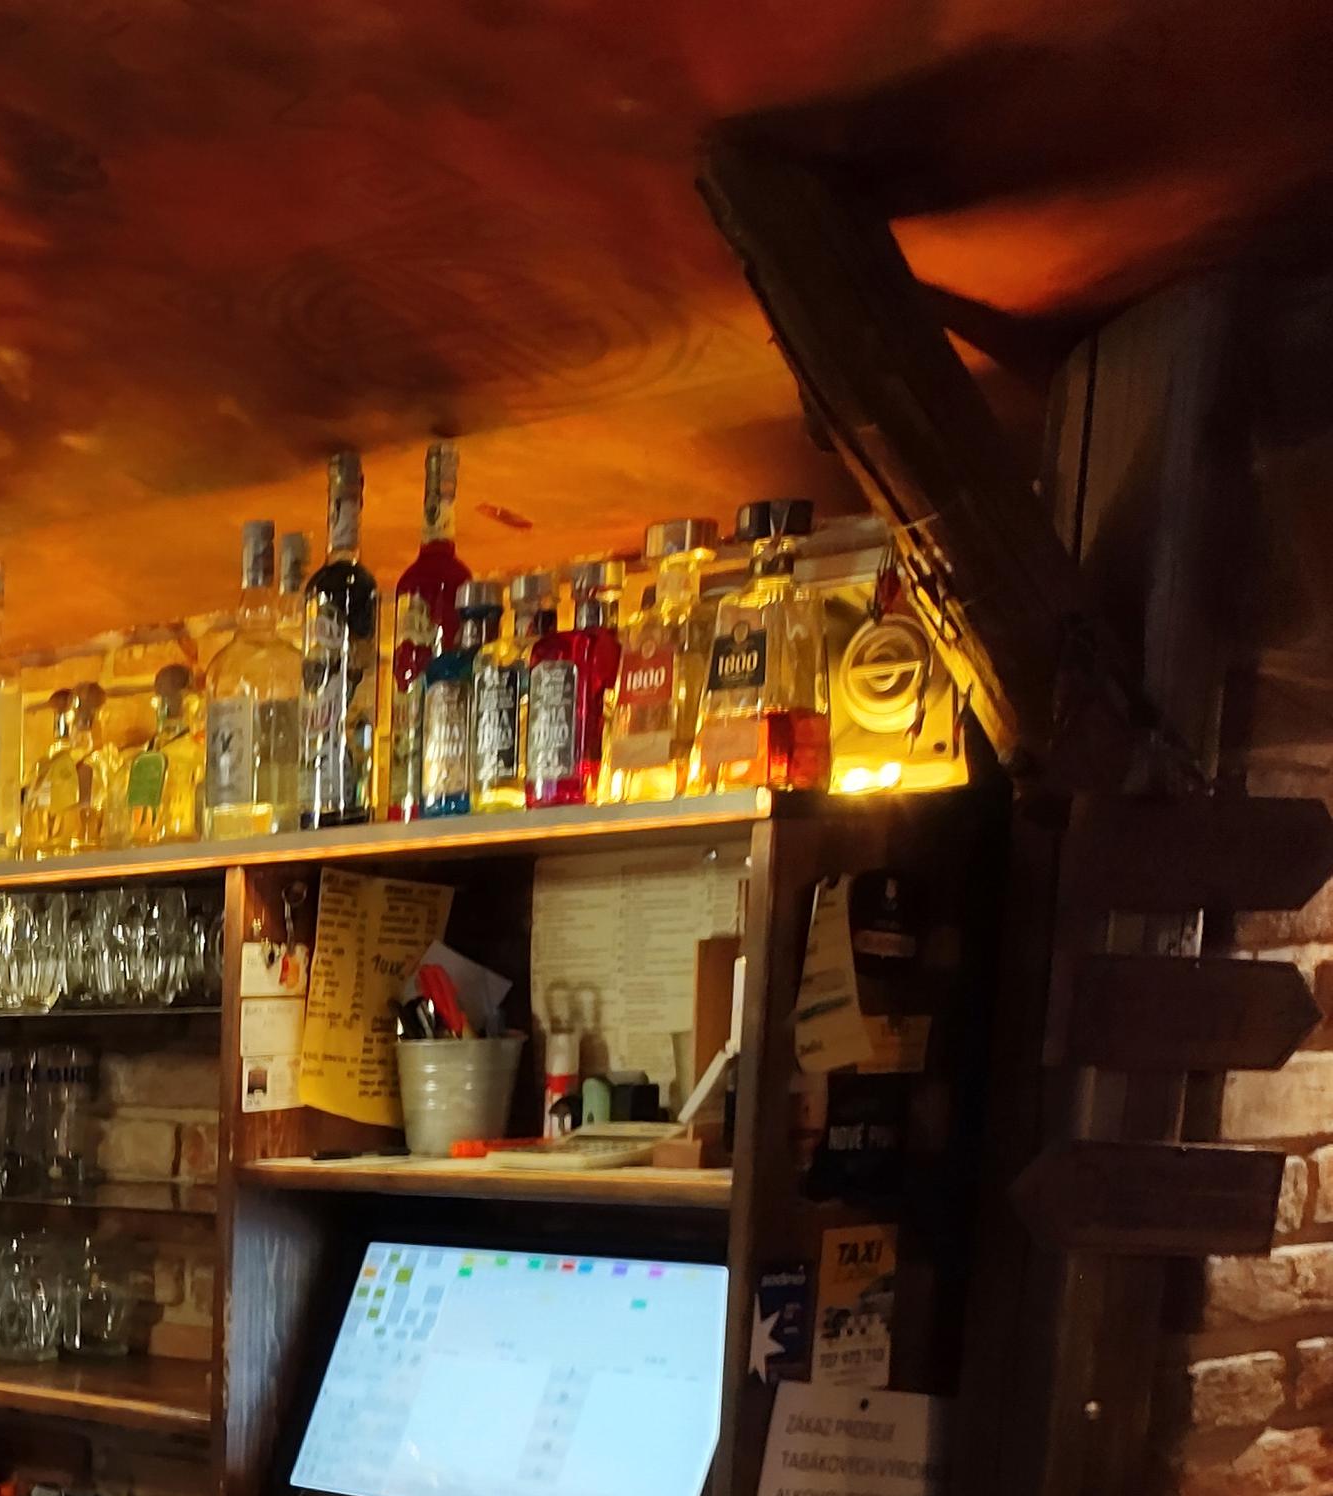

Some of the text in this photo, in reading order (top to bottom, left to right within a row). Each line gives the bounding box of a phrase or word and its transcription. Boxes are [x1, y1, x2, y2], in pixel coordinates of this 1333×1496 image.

[717, 652, 758, 677] 1800
[626, 667, 666, 693] 1800
[786, 1411, 833, 1437] ZÁKAZ
